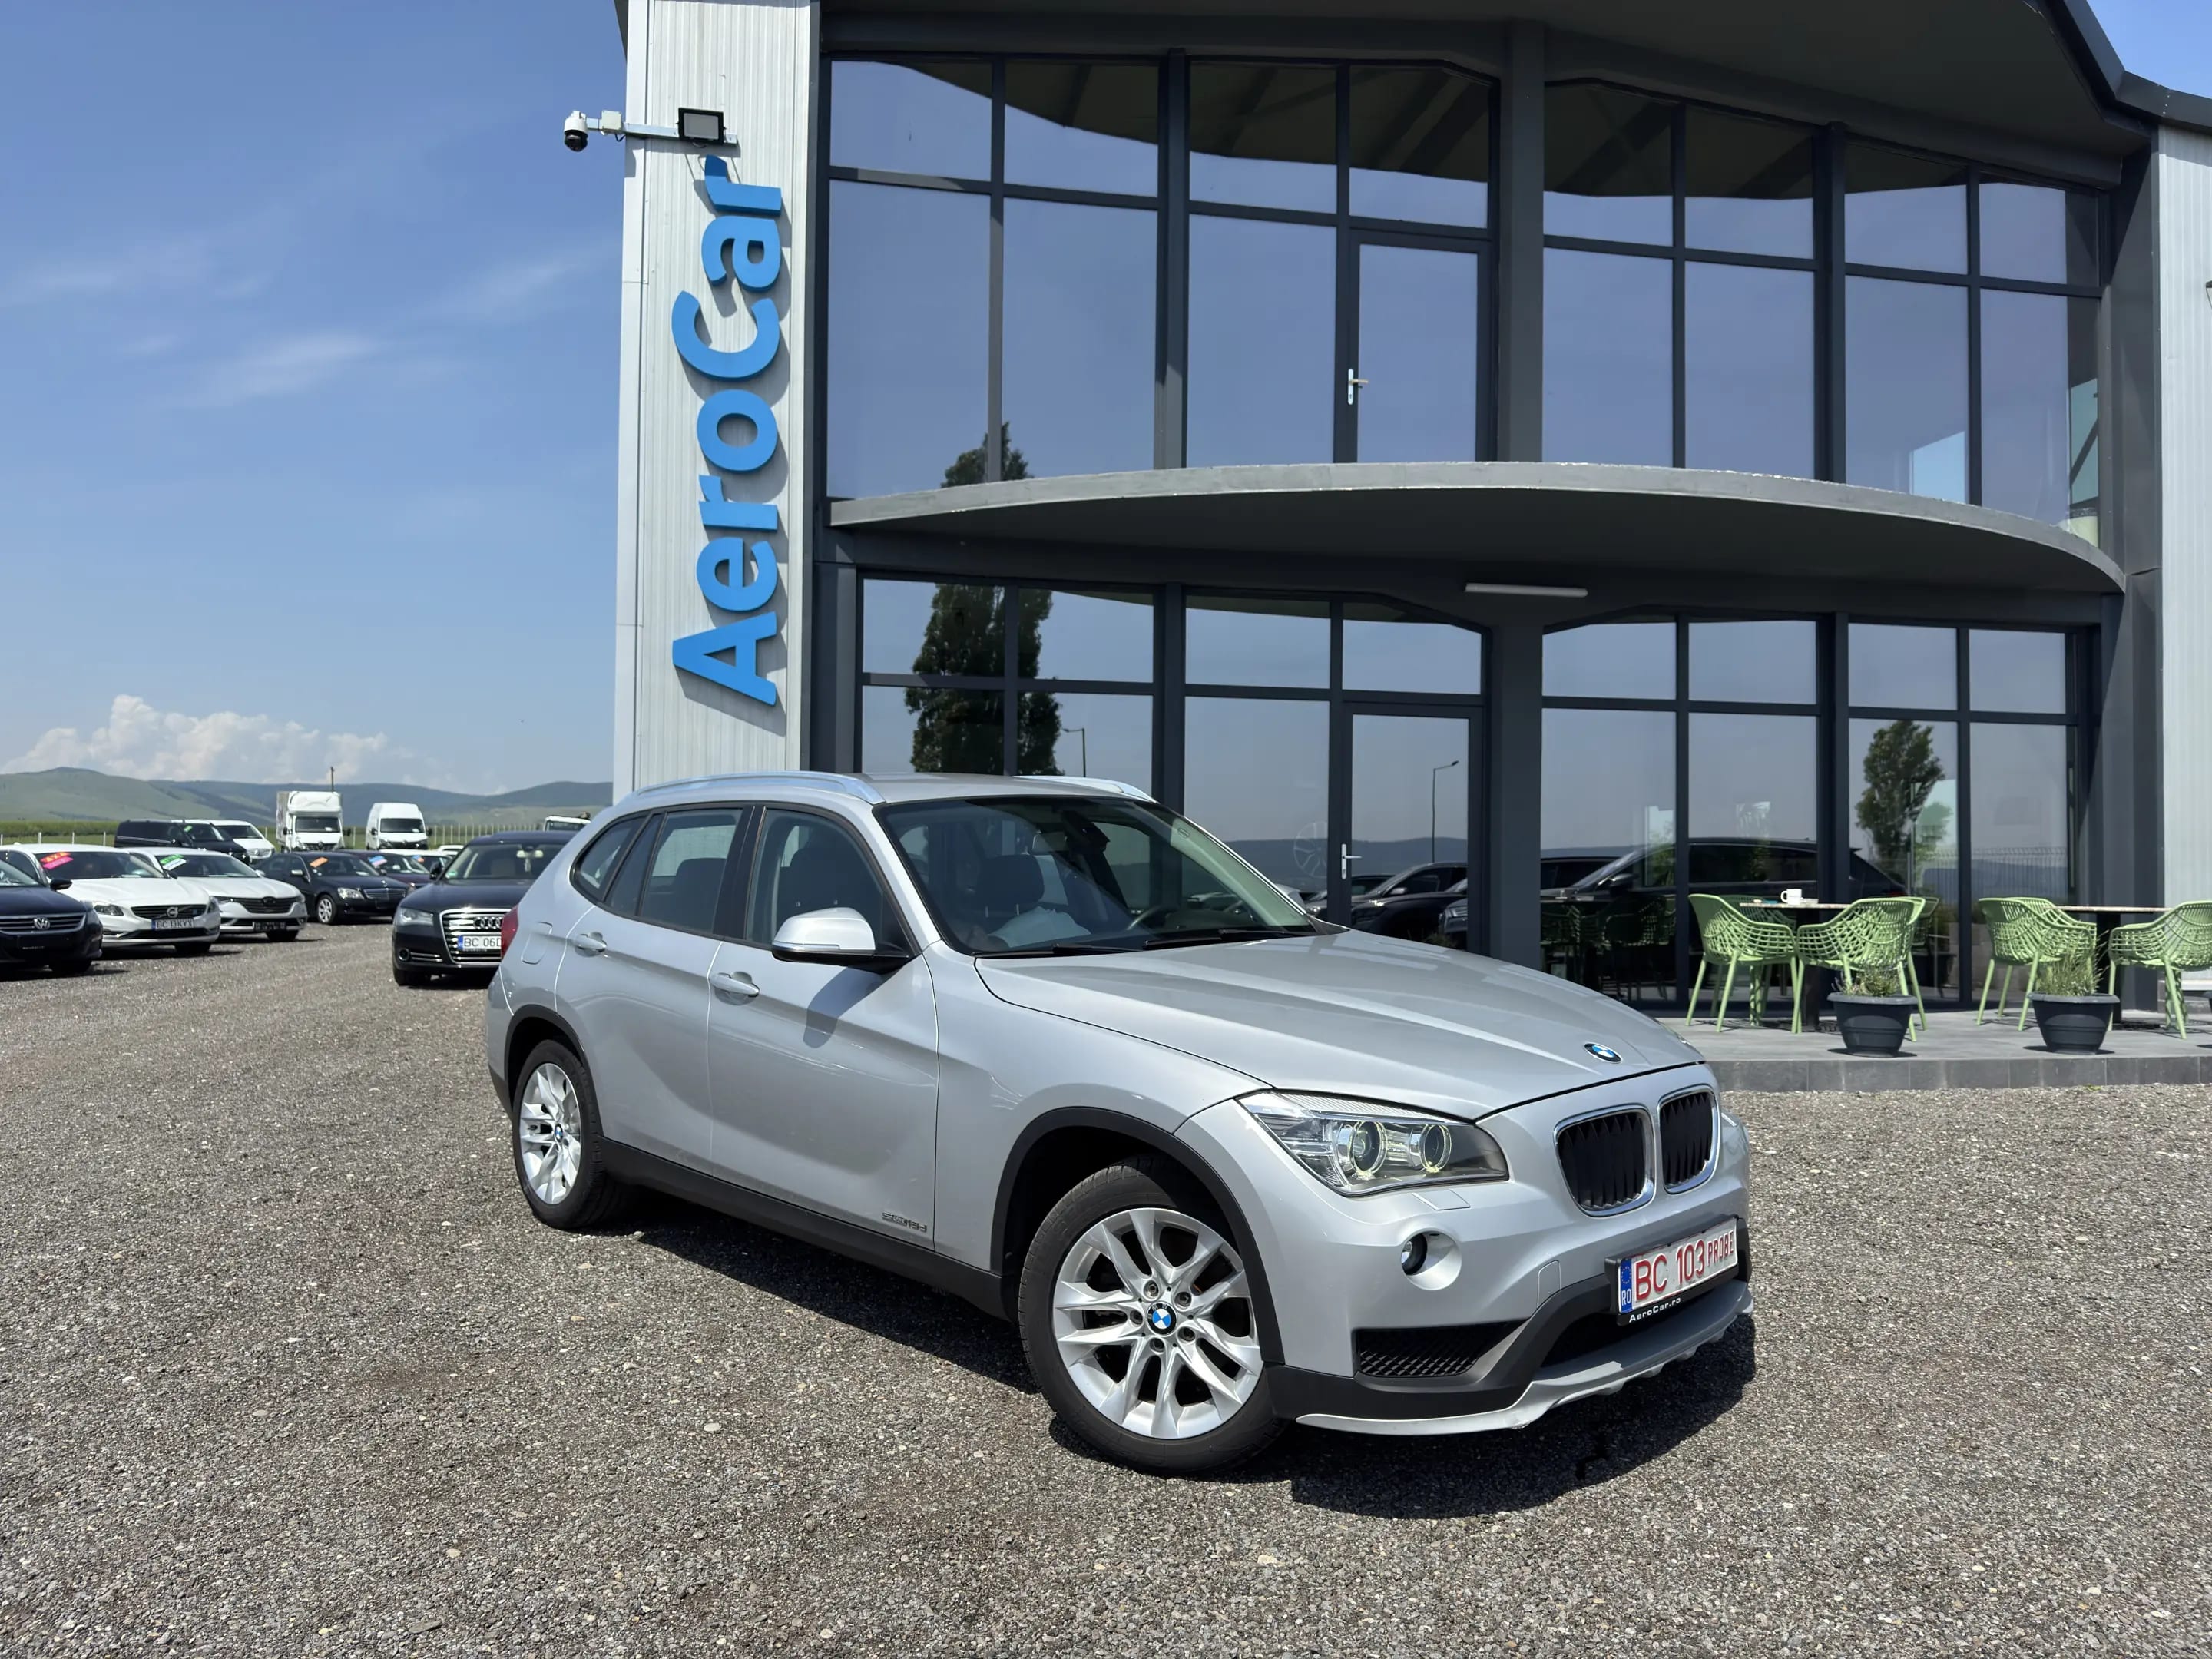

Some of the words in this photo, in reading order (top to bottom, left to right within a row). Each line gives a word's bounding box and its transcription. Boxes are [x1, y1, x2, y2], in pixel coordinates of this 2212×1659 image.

[672, 154, 783, 707] AeroCar
[464, 937, 479, 947] BC
[1634, 1253, 1667, 1301] BC
[1676, 1239, 1705, 1285] 103
[1707, 1230, 1734, 1266] PROBE
[1621, 1288, 1632, 1306] RO
[1628, 1296, 1681, 1323] AeroCar.ro
